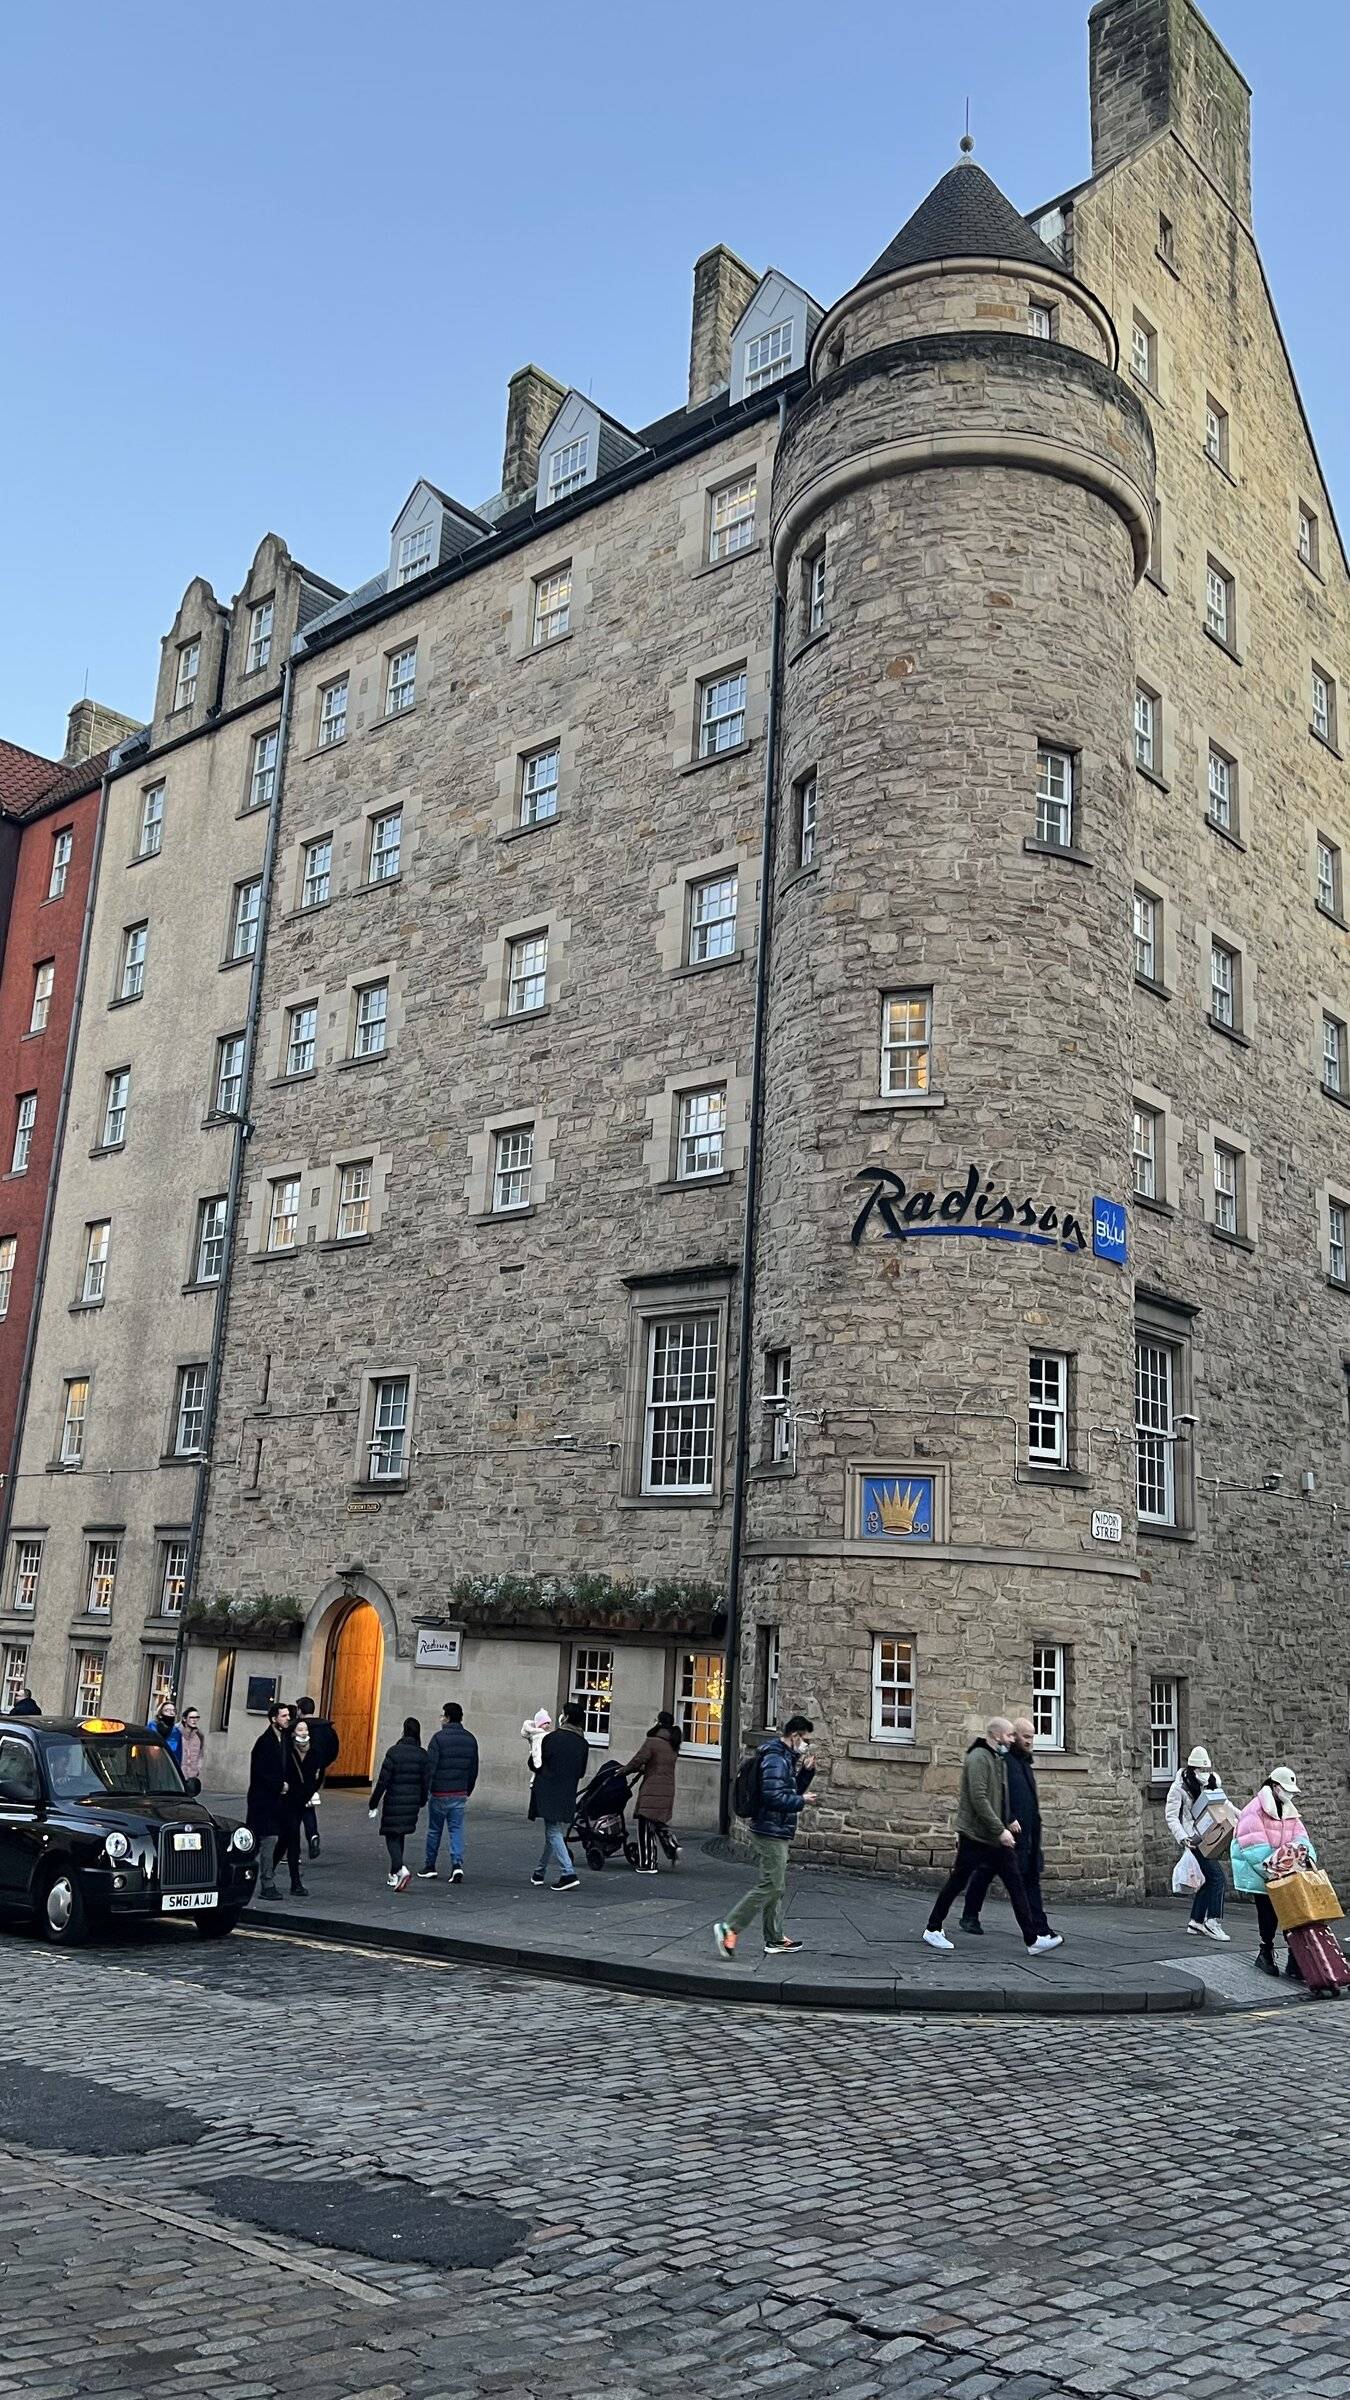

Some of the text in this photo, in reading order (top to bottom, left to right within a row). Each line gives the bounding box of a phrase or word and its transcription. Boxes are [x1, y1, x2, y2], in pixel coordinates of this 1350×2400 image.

[852, 1164, 1125, 1249] Radisson BLU
[913, 1522, 930, 1534] 90
[1095, 1525, 1119, 1539] STREET
[193, 1893, 213, 1906] AJU
